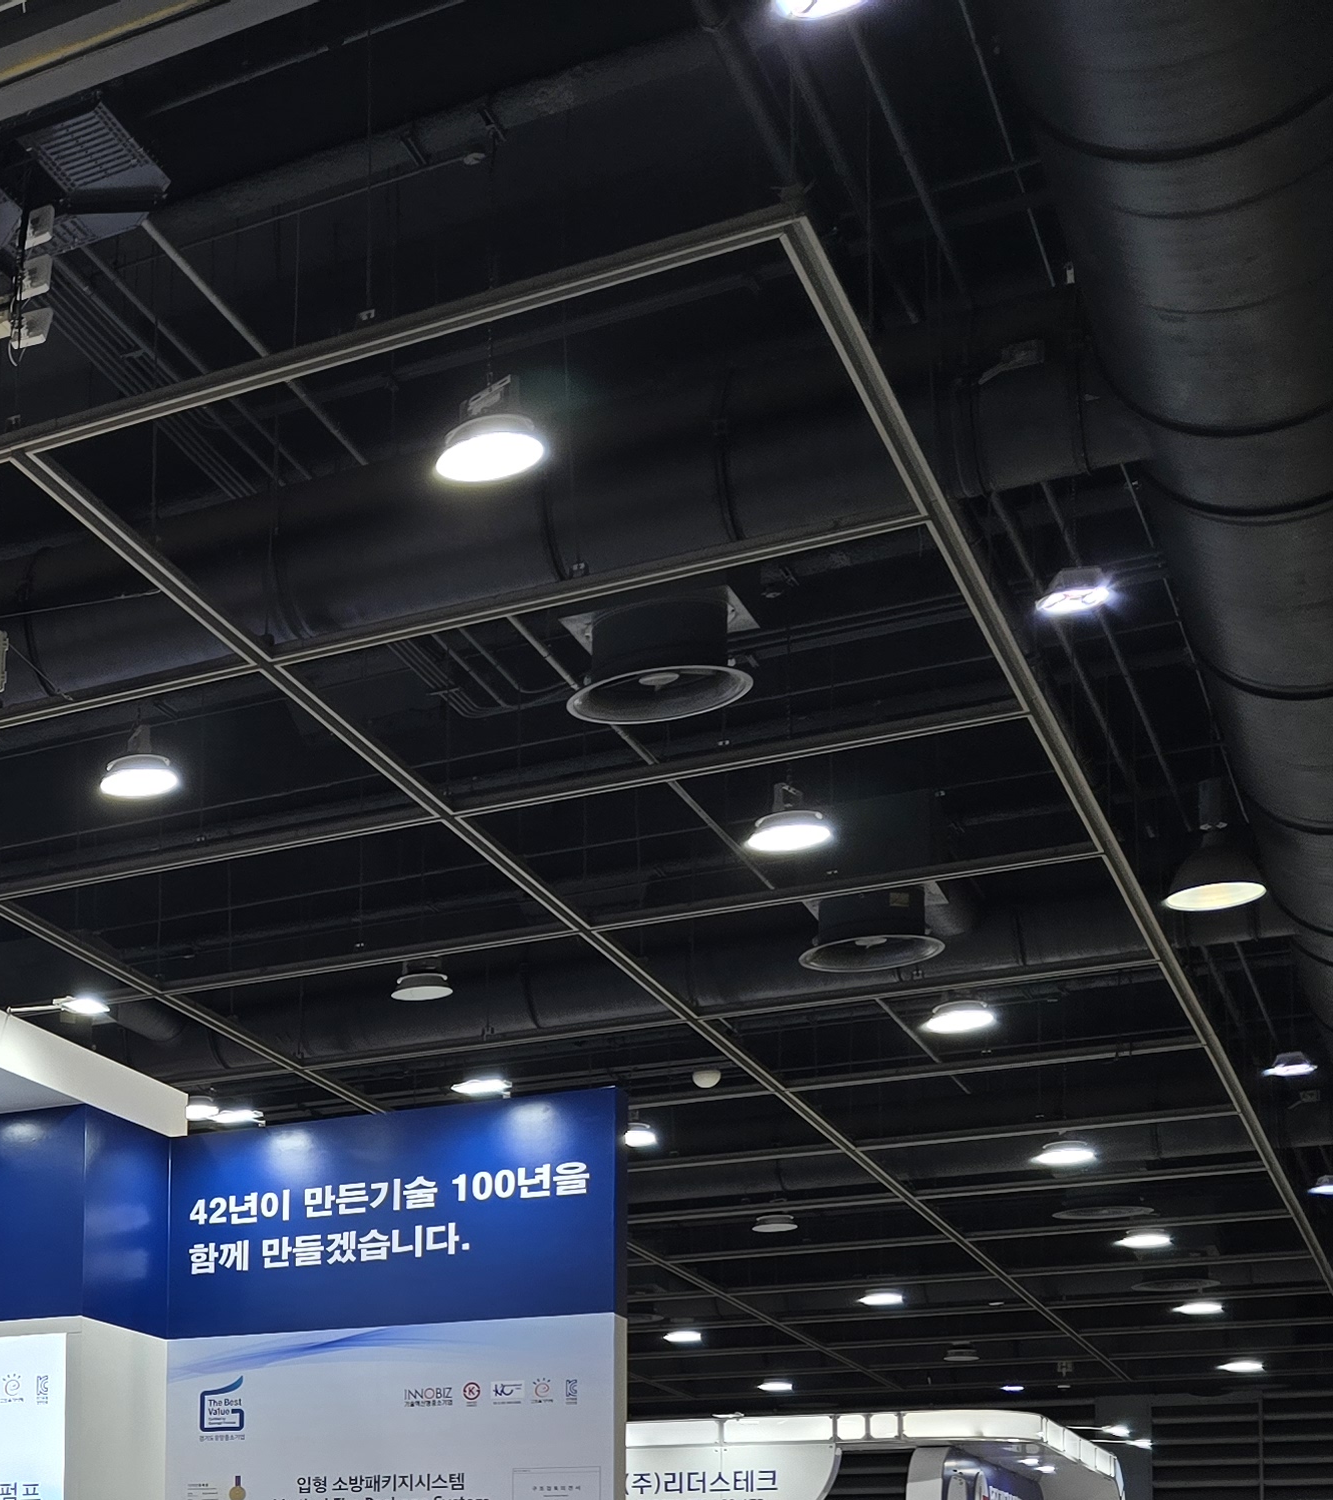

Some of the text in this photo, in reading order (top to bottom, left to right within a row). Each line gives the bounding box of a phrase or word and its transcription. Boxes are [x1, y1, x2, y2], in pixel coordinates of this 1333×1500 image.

[189, 1161, 590, 1225] 42년이 만든기술 100년을
[189, 1223, 471, 1274] 함께 만들겠습니다.
[208, 1399, 222, 1407] The
[296, 1472, 466, 1495] 입형 소방패키지시스템
[625, 1469, 778, 1495] (주)리더스테크
